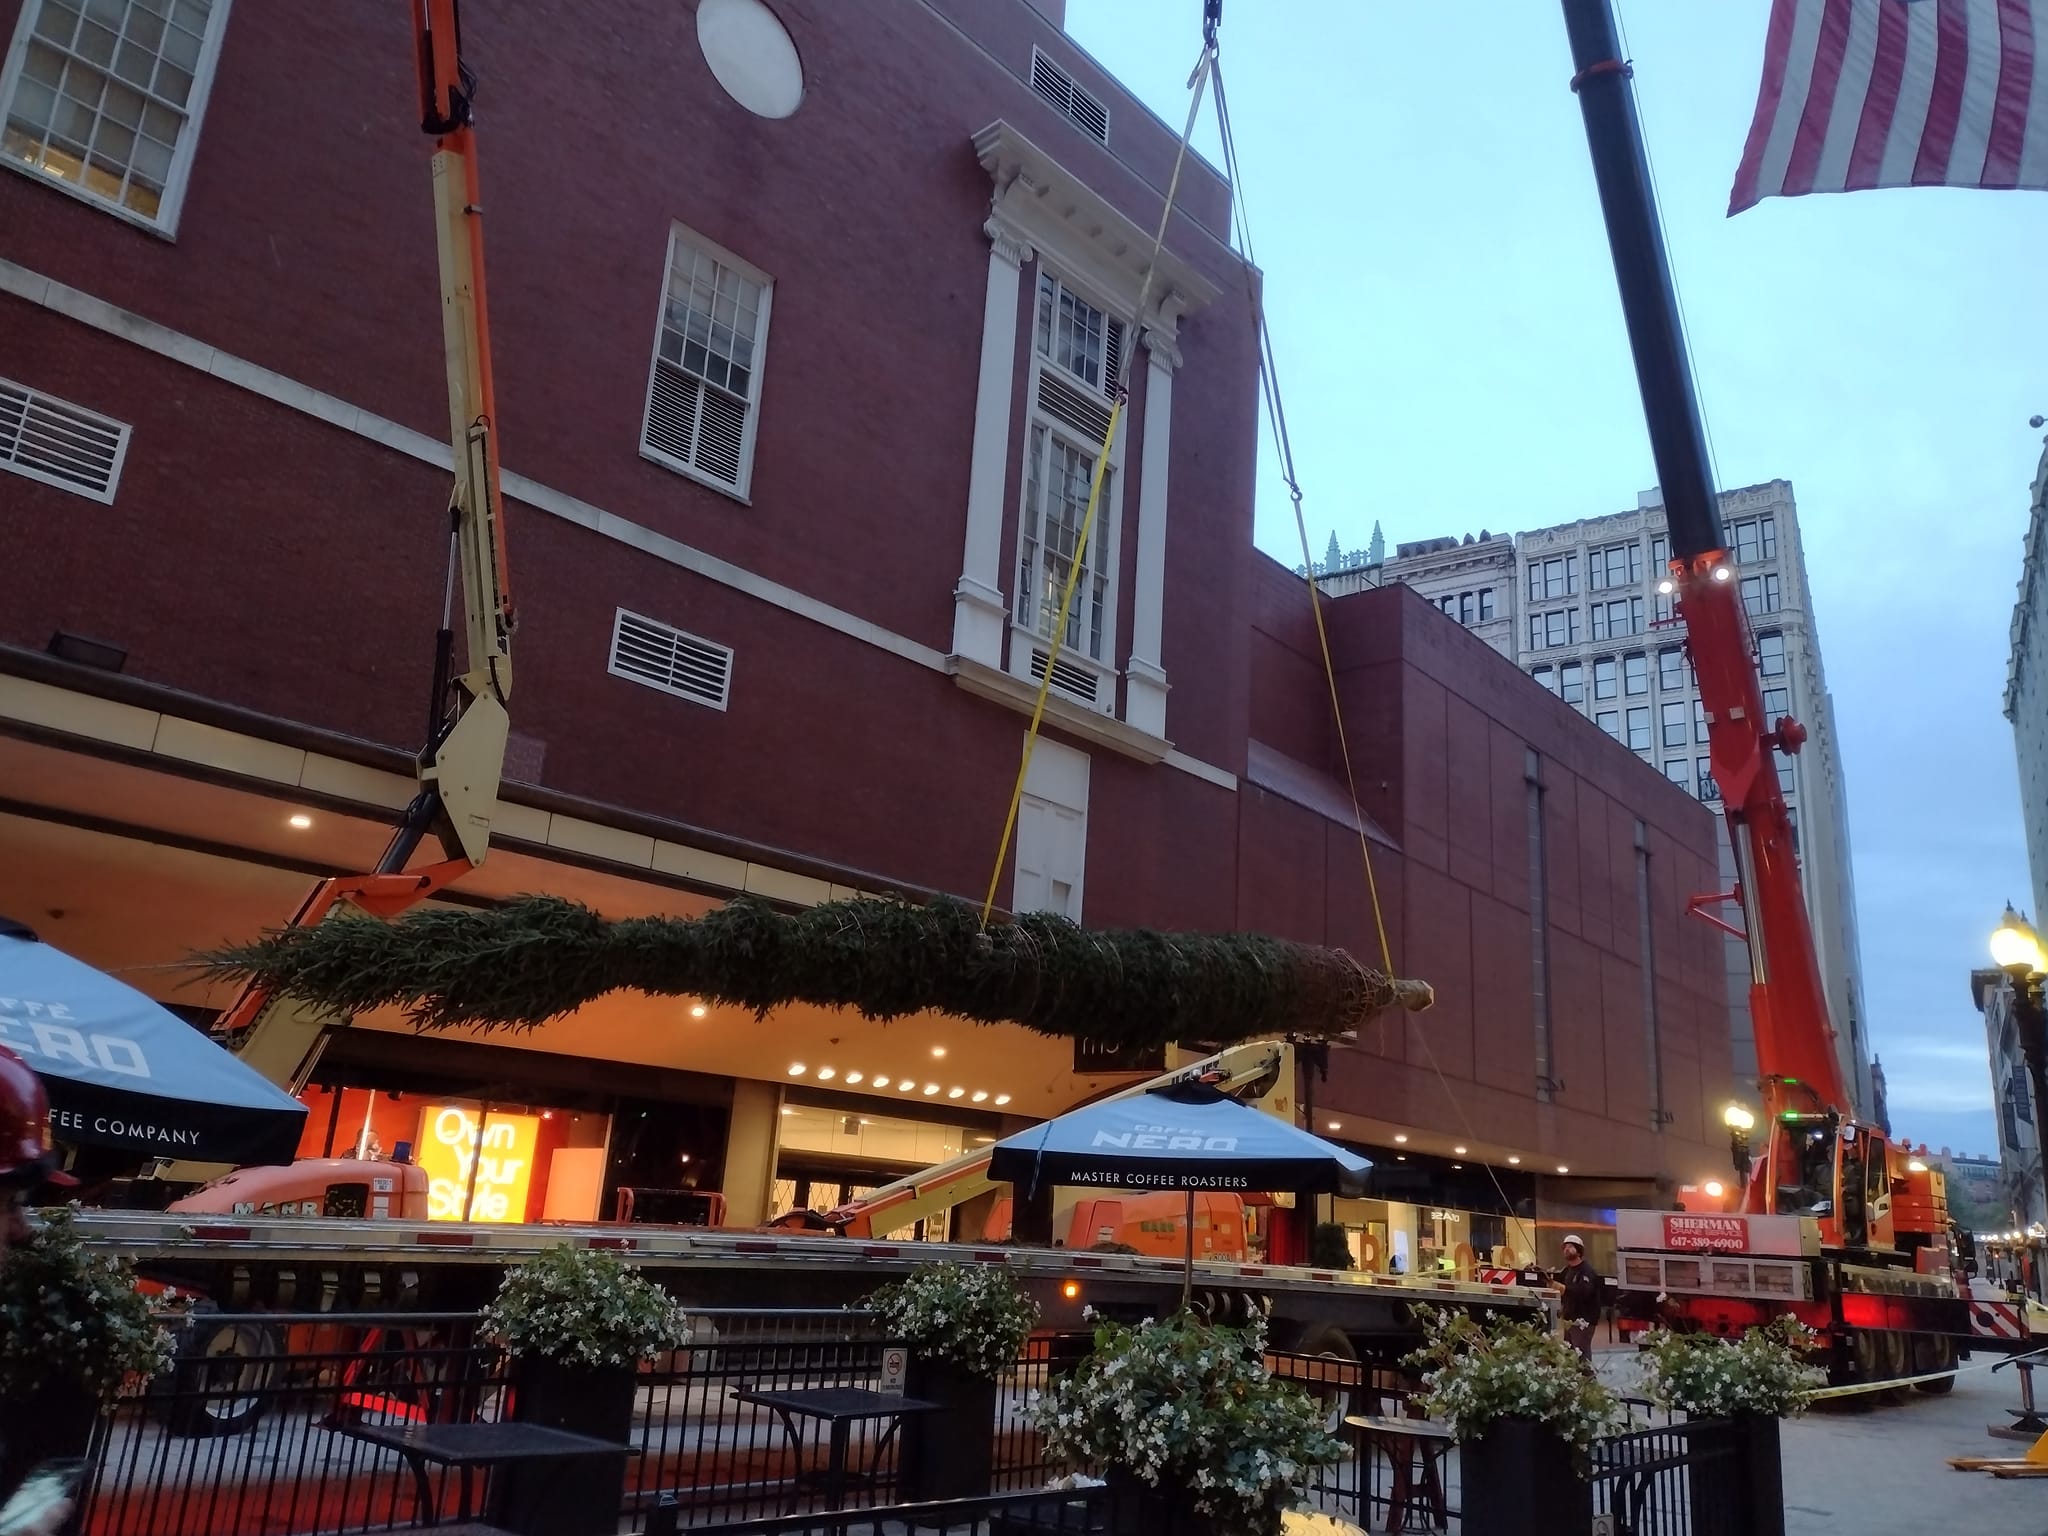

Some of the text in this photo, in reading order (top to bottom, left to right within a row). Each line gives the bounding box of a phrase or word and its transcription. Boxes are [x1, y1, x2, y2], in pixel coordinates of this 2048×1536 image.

[94, 1117, 200, 1145] COMPANY
[1091, 1130, 1239, 1151] NERO
[1071, 1171, 1248, 1187] MASTER COFFEE ROASTERS
[1670, 1217, 1741, 1231] SHERMAN
[1670, 1228, 1745, 1237] CRANE SERVICE
[1671, 1236, 1744, 1249] 617-389-6900
